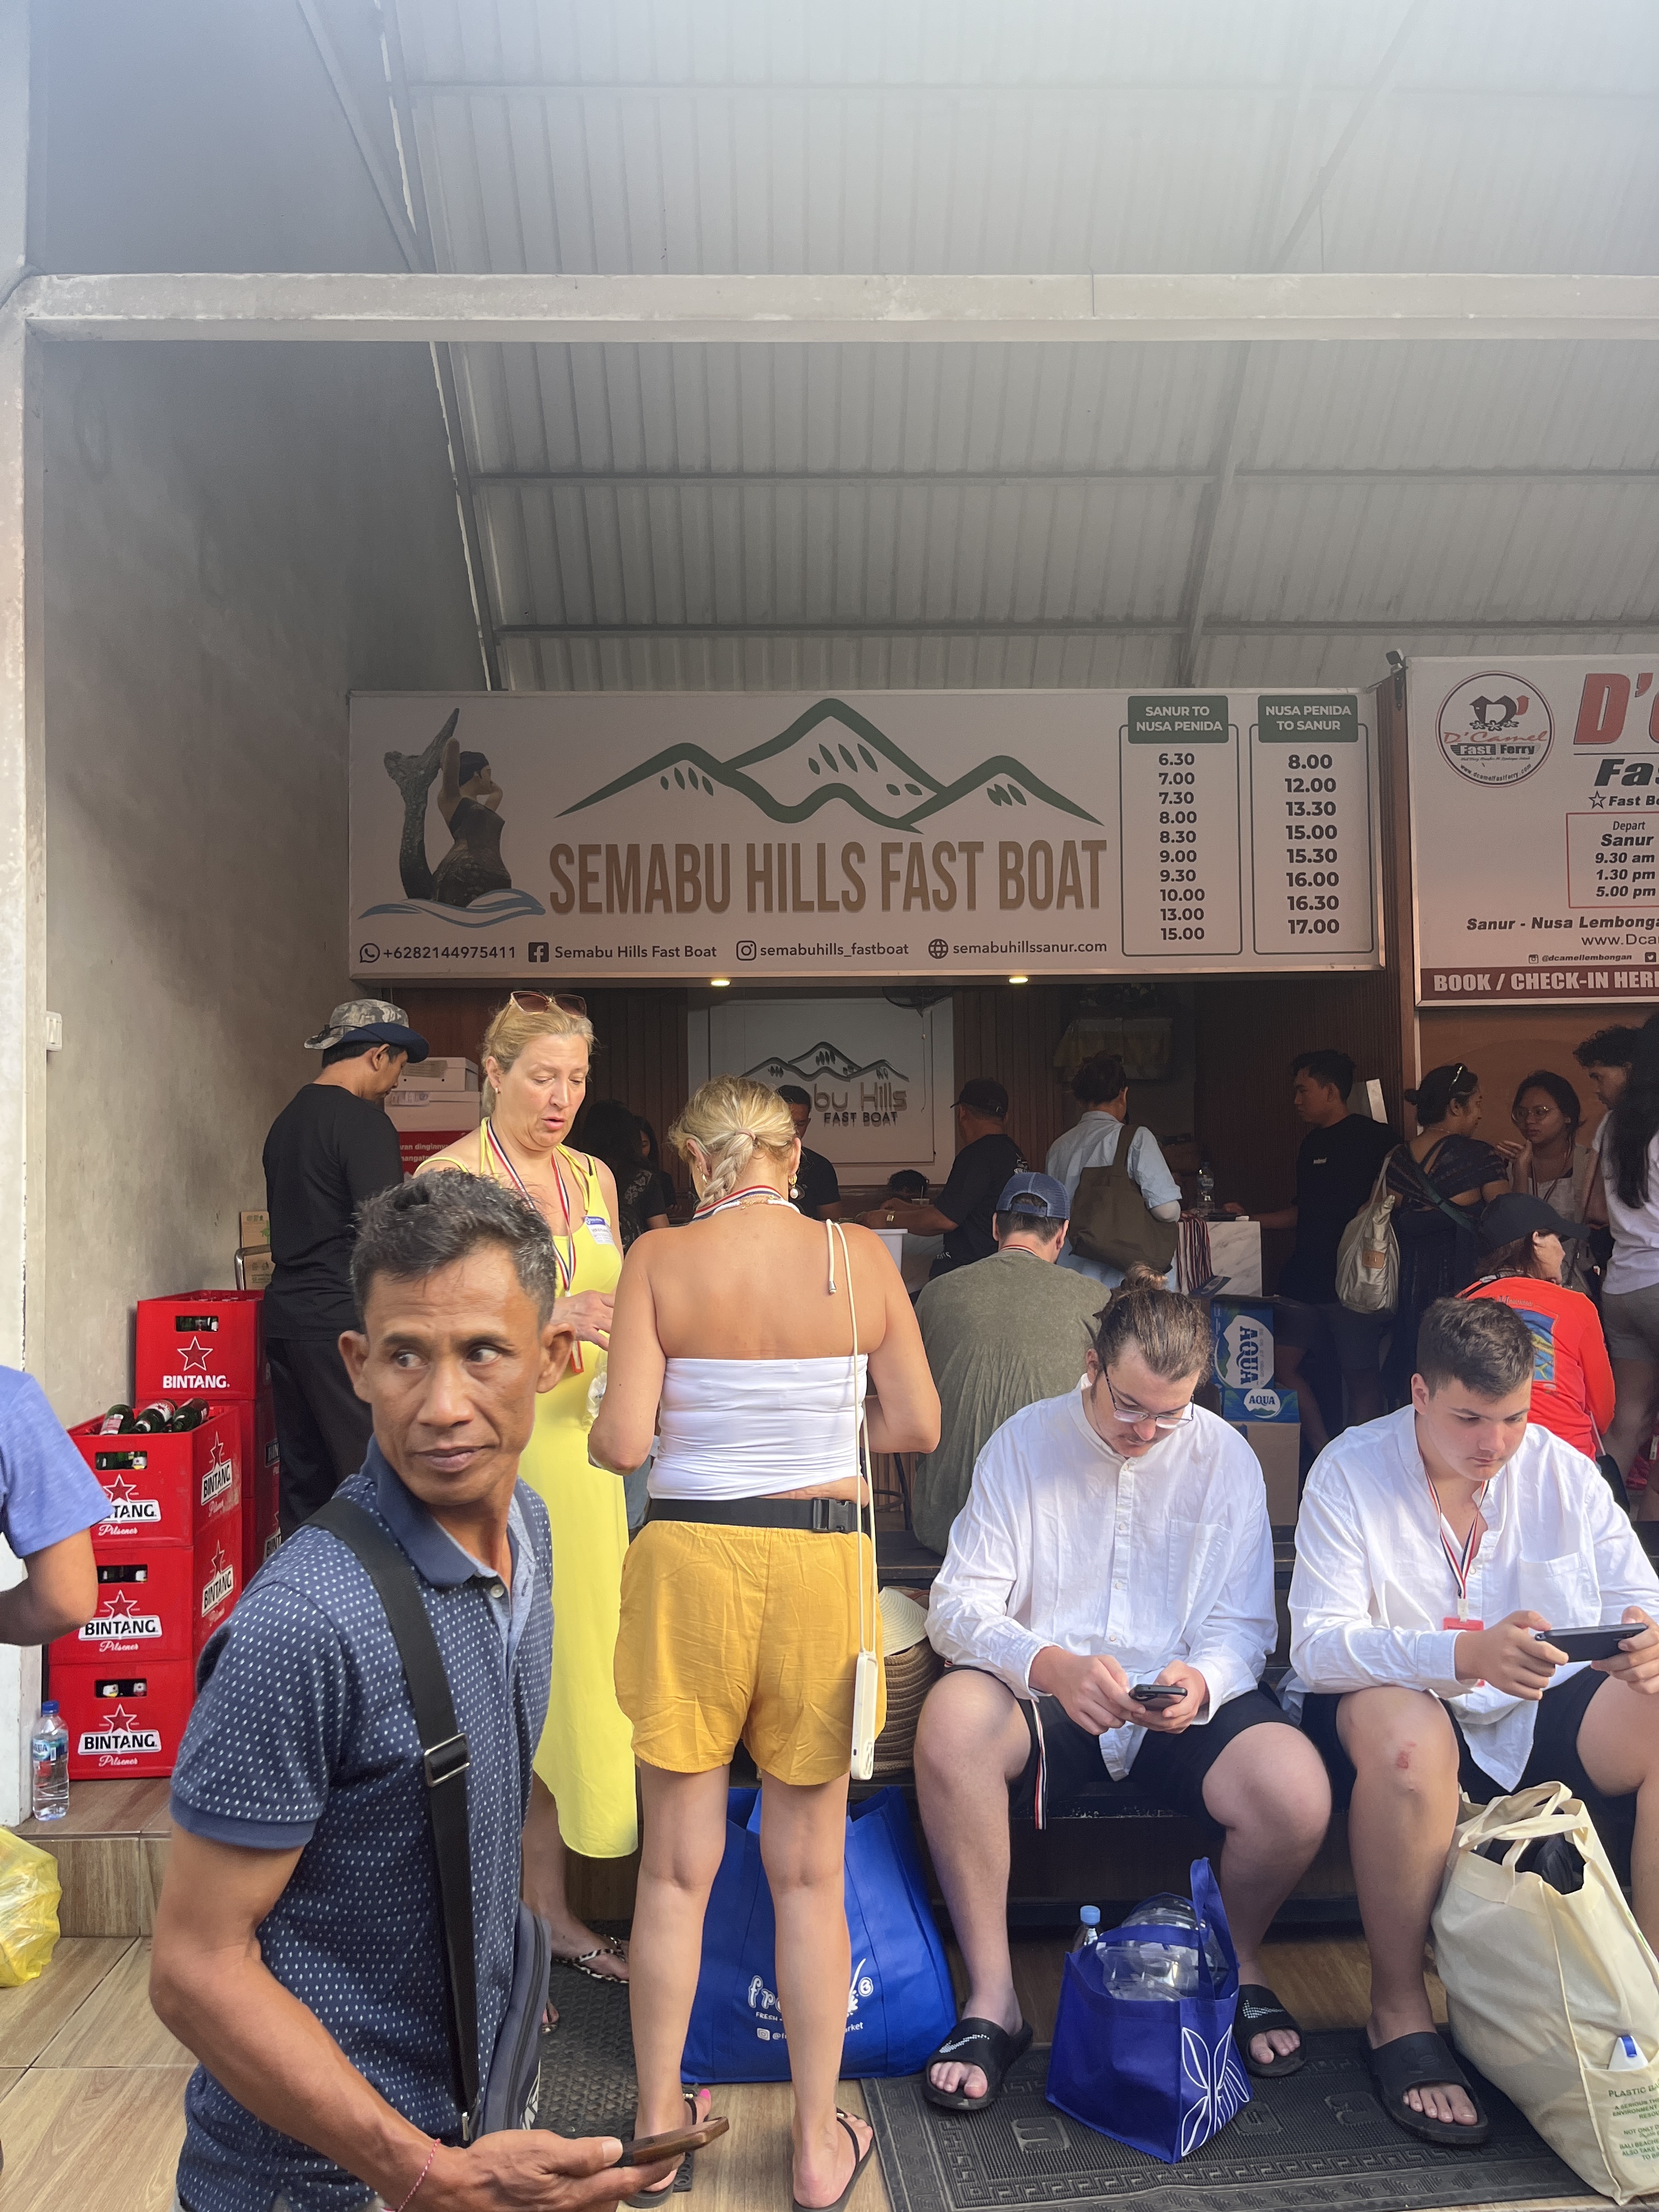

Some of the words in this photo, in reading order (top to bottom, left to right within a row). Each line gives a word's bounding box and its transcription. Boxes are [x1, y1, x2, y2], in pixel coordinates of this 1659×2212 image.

[1145, 706, 1189, 717] SANUR
[1191, 706, 1210, 716] TO
[1266, 706, 1301, 716] NUSA
[1304, 705, 1352, 715] PENIDA
[1136, 721, 1172, 732] NUSA
[1175, 721, 1223, 731] PENIDA
[1276, 720, 1295, 731] TO
[1297, 720, 1341, 731] SANUR
[1159, 753, 1195, 766] 6.30
[1288, 754, 1333, 769] 8.00
[1159, 772, 1195, 785] 7.00
[1285, 778, 1336, 793] 12.00
[1159, 792, 1194, 805] 7.30
[1609, 795, 1640, 806] Fast
[1285, 801, 1336, 816] 13.30
[1159, 811, 1197, 824] 8.00
[1285, 825, 1338, 840] 15.00
[1612, 821, 1646, 831] Depart
[1159, 831, 1197, 843] 8.30
[1600, 833, 1655, 847] Sanur
[1159, 850, 1197, 863] 9.00
[1286, 848, 1338, 864] 15.30
[1595, 853, 1628, 864] 9.30
[1632, 854, 1655, 863] am
[550, 843, 731, 915] SEMABU
[746, 842, 866, 913] HILLS
[881, 840, 984, 912] FAST
[998, 839, 1107, 911] BOAT
[1160, 870, 1196, 882] 9.30
[1286, 872, 1339, 887] 16.00
[1595, 870, 1628, 881] 1.30
[1632, 871, 1656, 882] pm
[1160, 888, 1205, 901] 10.00
[1595, 886, 1629, 897] 5.00
[1633, 887, 1656, 899] pm
[1287, 895, 1339, 911] 16.30
[1160, 908, 1204, 921] 13.00
[1288, 919, 1340, 934] 17.00
[1466, 918, 1515, 930] Sanur
[1531, 917, 1573, 929] Nusa
[1160, 927, 1205, 940] 15.00
[382, 946, 516, 959] +6282144975411
[554, 945, 613, 958] Semabu
[618, 945, 648, 958] Hills
[652, 945, 680, 958] Fast
[684, 944, 718, 958] Boat
[760, 942, 909, 958] semabuhills_fastboat
[953, 940, 1108, 954] semabuhillssanur.com
[1542, 953, 1633, 962] @dcamellembongan
[1434, 973, 1491, 991] BOOK
[1510, 972, 1609, 990] CHECK-IN
[860, 1082, 907, 1109] Hills
[824, 1111, 857, 1124] FAST
[863, 1111, 898, 1123] BOAT
[1236, 1325, 1259, 1385] AQUA
[162, 1375, 226, 1389] BINTANG
[1249, 1395, 1276, 1406] AQUA
[204, 1464, 230, 1499] BINTANG
[112, 1504, 155, 1519] TANG
[98, 1524, 138, 1536] Pilsener
[204, 1570, 232, 1610] BINTANG
[84, 1619, 156, 1635] BINTANG
[99, 1640, 138, 1652] Pilsener
[84, 1734, 156, 1750] BINTANG
[99, 1755, 138, 1767] Pilsener
[755, 2011, 778, 2022] FRESH
[1608, 2087, 1646, 2097] PLASTIC
[1612, 2104, 1657, 2117] ENVIRONMENT
